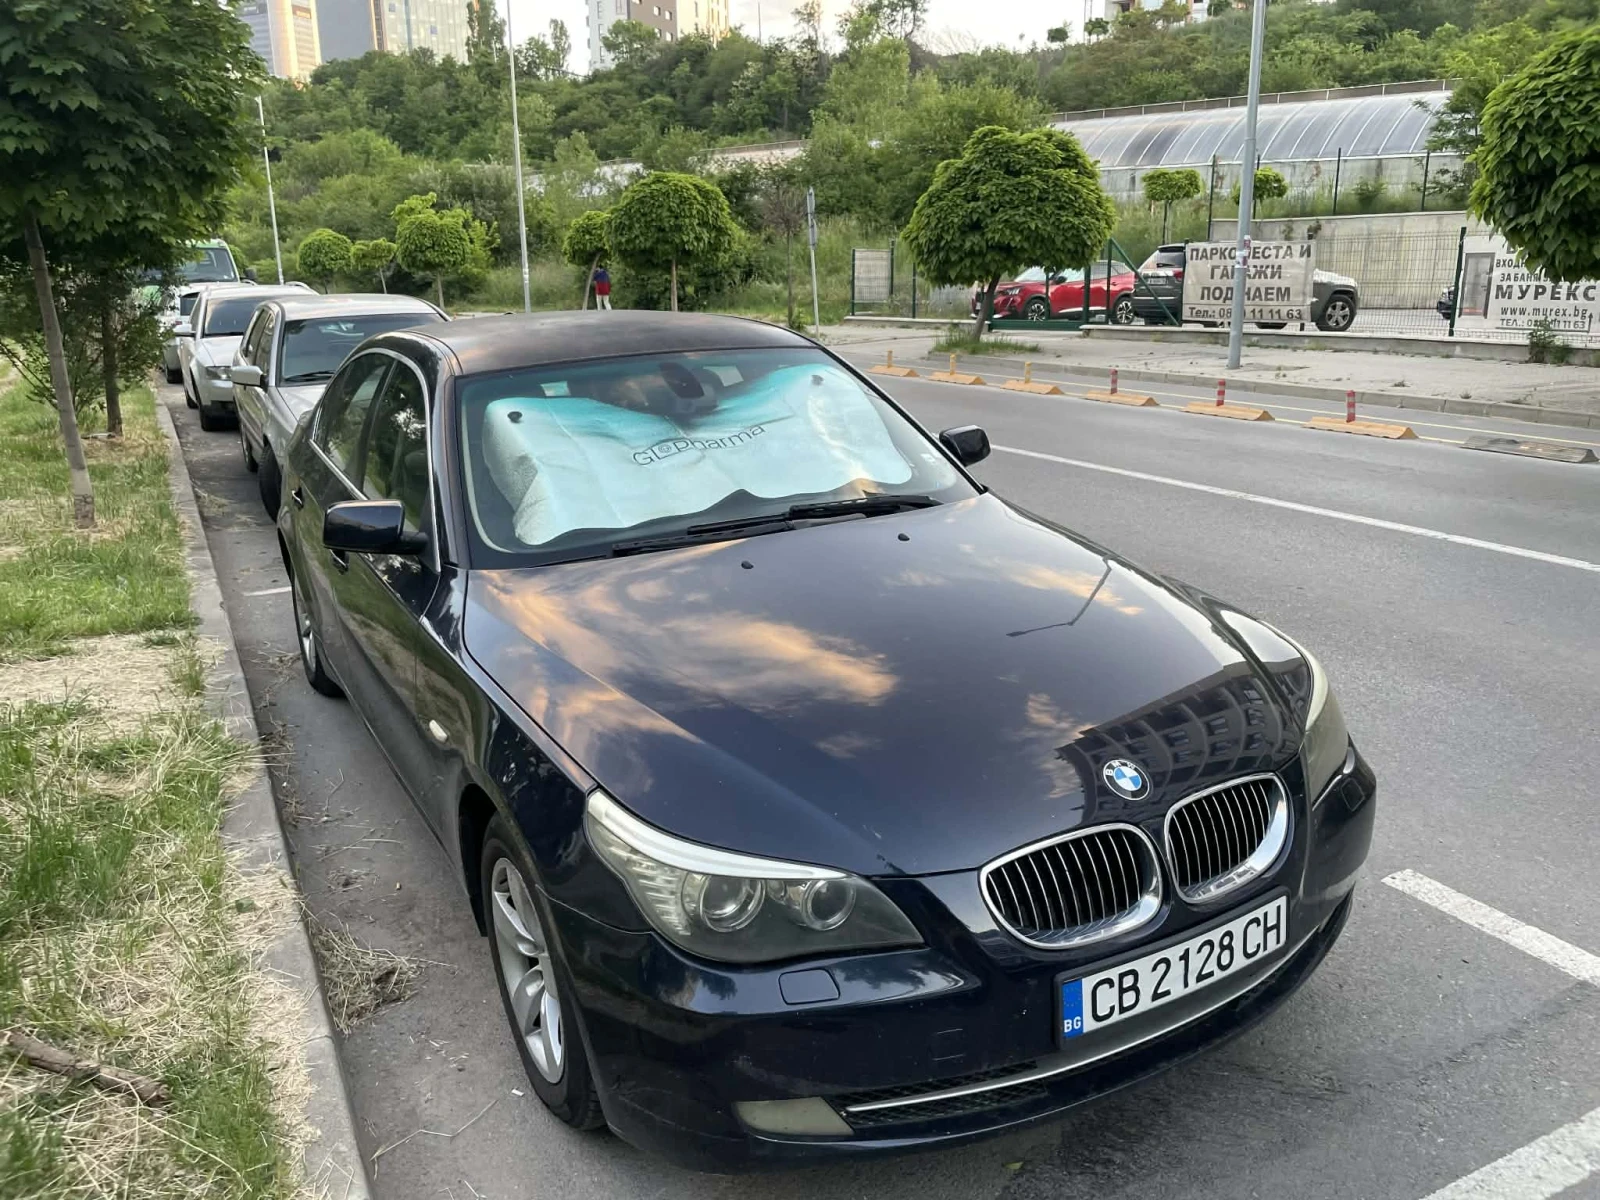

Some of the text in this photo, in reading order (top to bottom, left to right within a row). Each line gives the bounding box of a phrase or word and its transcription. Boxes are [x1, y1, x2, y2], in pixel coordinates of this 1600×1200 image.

[1190, 244, 1311, 261] ПАРКОЕСТА И
[1500, 273, 1512, 282] ЗА
[1494, 284, 1597, 302] МУРЕКС
[1189, 307, 1216, 319] Тел.:
[1251, 309, 1264, 320] 11
[1268, 309, 1281, 320] 11
[1286, 309, 1302, 320] 63
[1501, 305, 1588, 320] www.murex.bg
[1573, 320, 1586, 329] 63
[1091, 904, 1281, 1022] CB 2128 CH
[1063, 1016, 1082, 1033] BG
